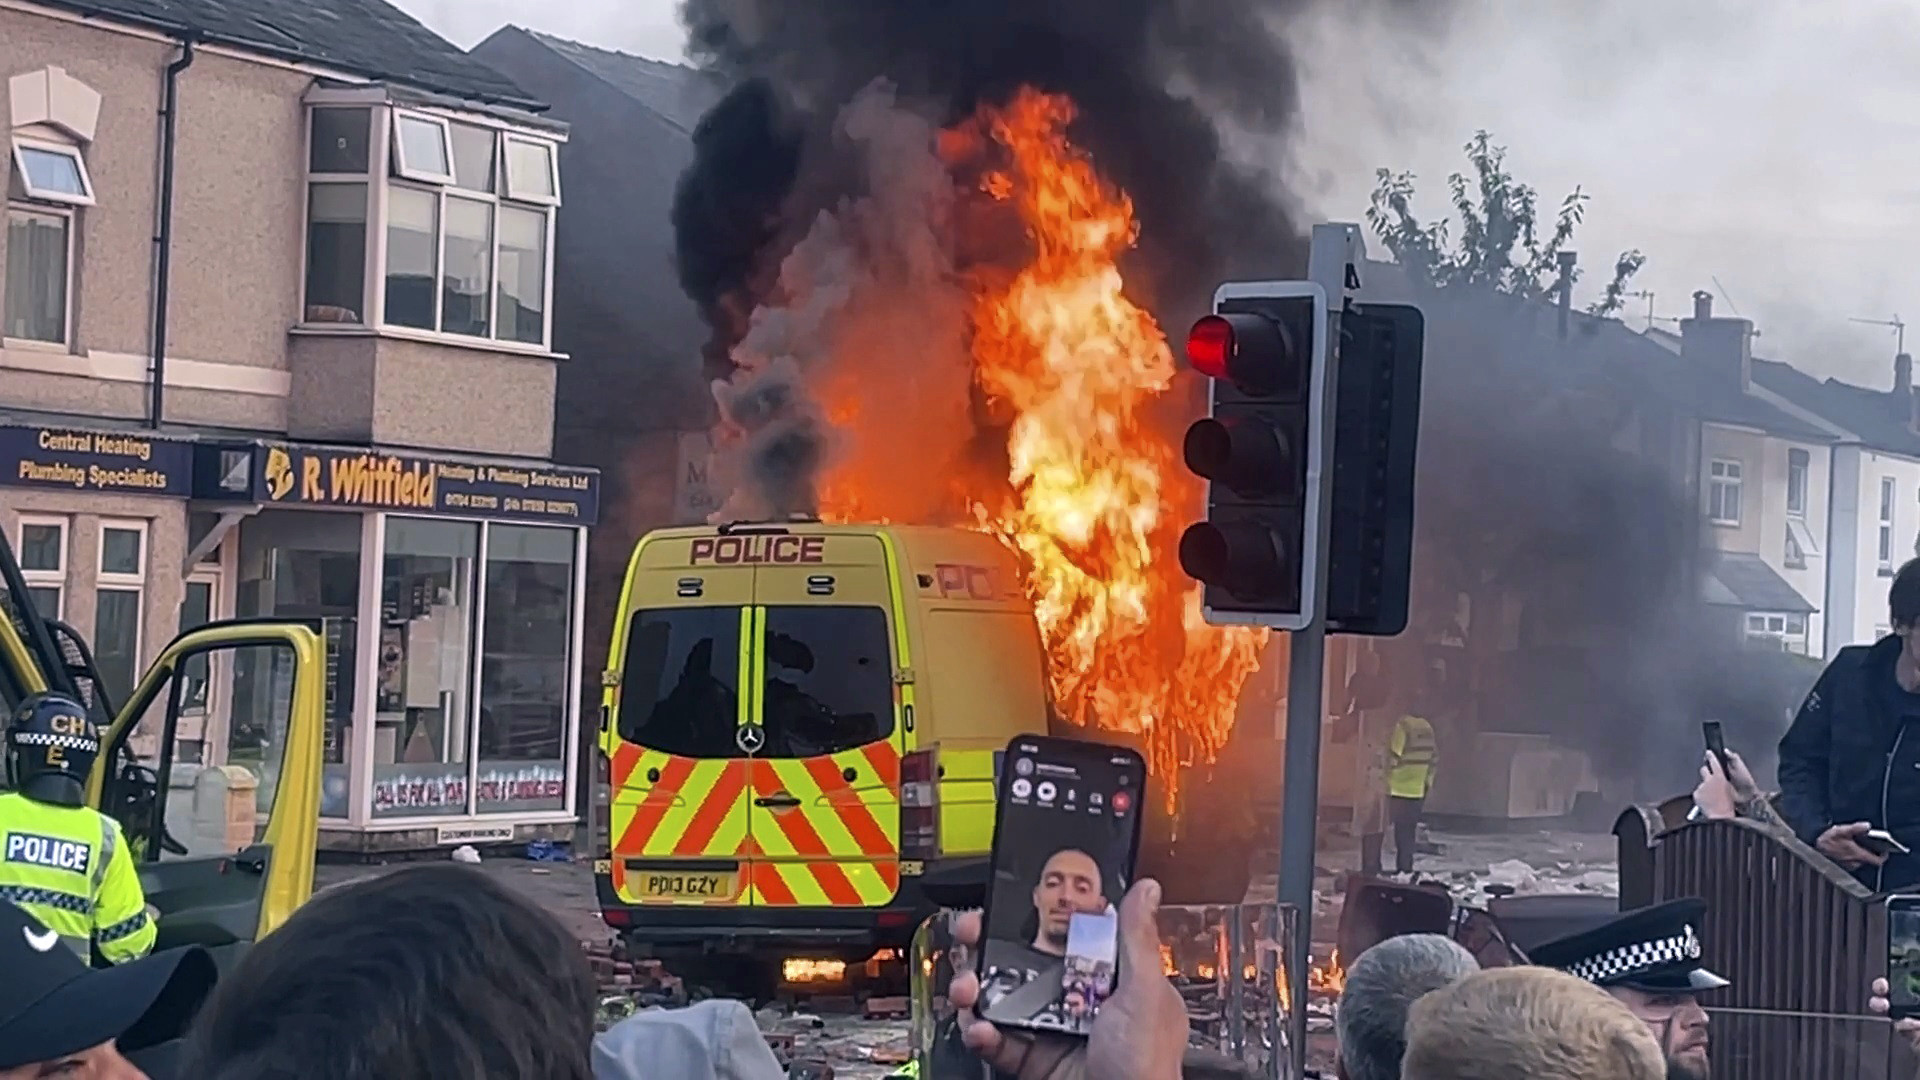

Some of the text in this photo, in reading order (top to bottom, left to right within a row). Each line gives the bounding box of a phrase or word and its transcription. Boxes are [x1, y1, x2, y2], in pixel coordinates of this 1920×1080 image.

[39, 431, 151, 460] Central Heating
[19, 460, 166, 488] Plumbing Specialists
[330, 455, 435, 507] Whitfield
[477, 467, 485, 480] &
[531, 471, 570, 488] Services
[690, 537, 825, 565] POLICE
[8, 835, 88, 870] POLICE
[687, 875, 718, 894] GZY
